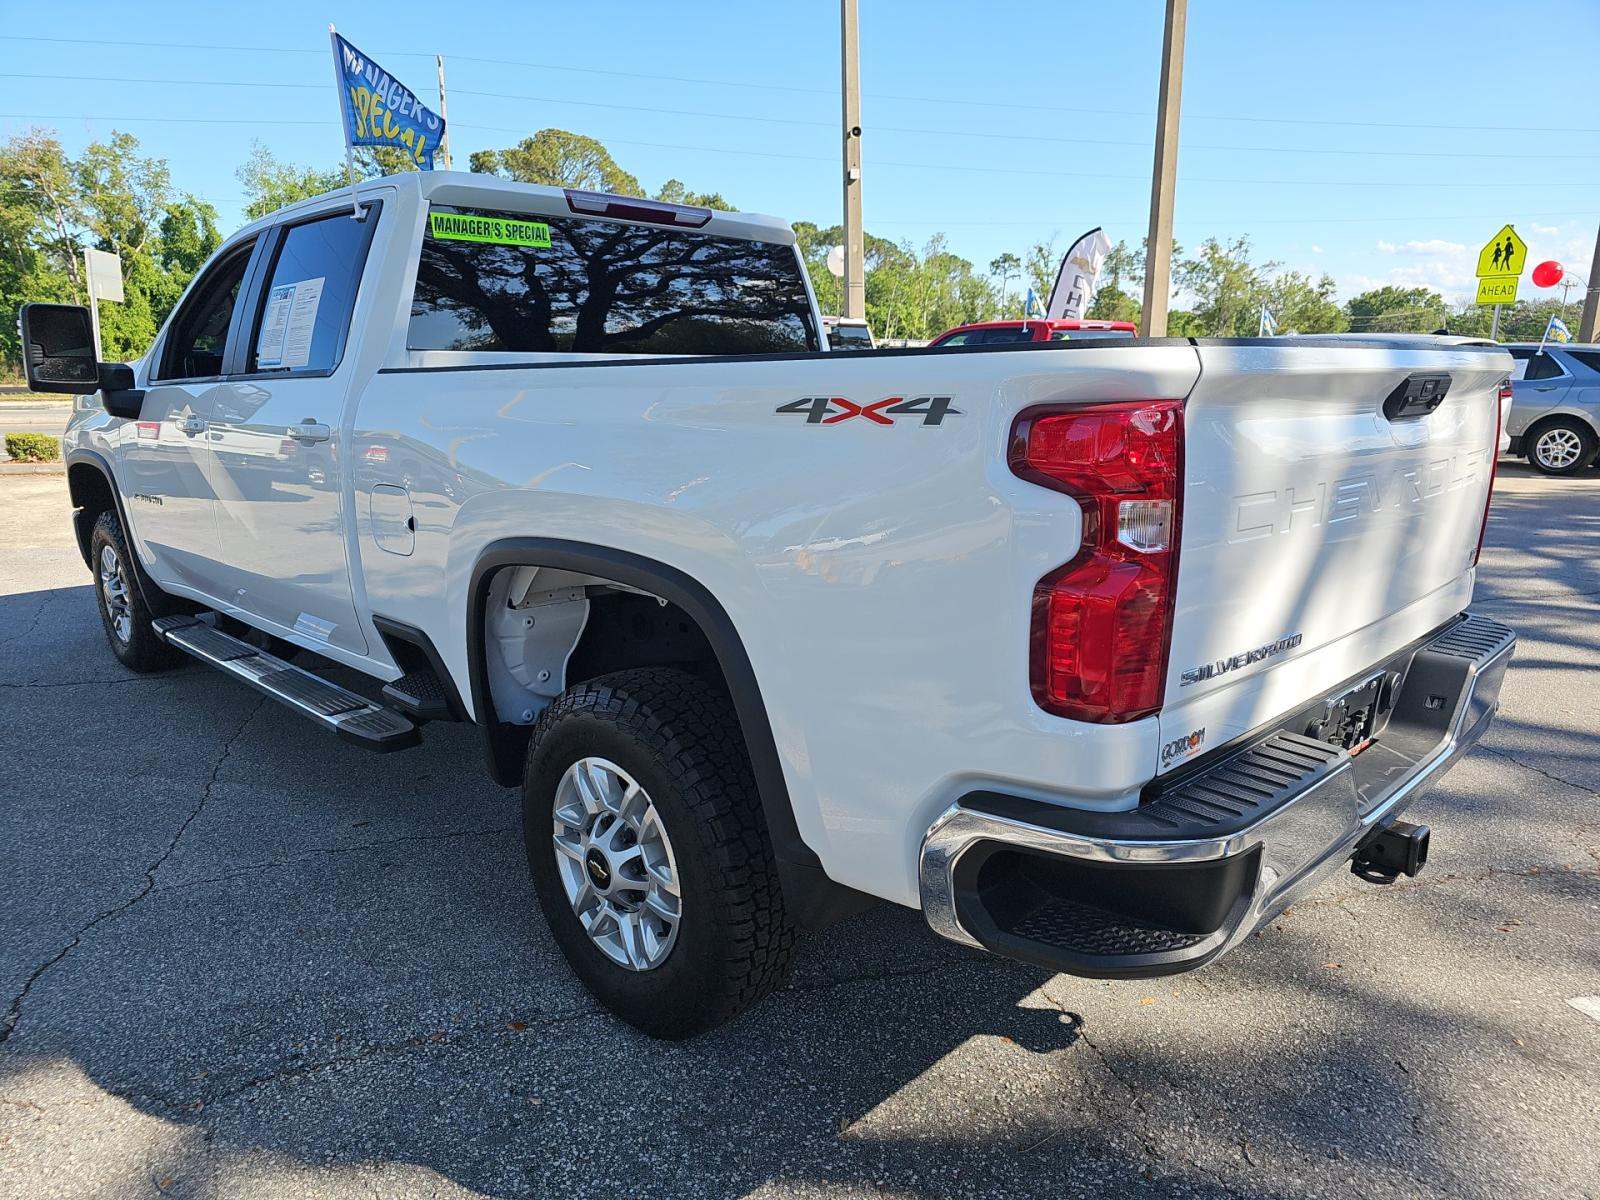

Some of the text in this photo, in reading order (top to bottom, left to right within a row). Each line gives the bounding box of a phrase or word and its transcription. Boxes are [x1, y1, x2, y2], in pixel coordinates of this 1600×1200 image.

[342, 44, 439, 130] MANAGERS
[351, 86, 425, 163] SPECAL
[434, 216, 548, 241] MANAGER'S SPECIAL
[1480, 285, 1514, 296] AHEAD
[1179, 633, 1303, 687] SILVERADO
